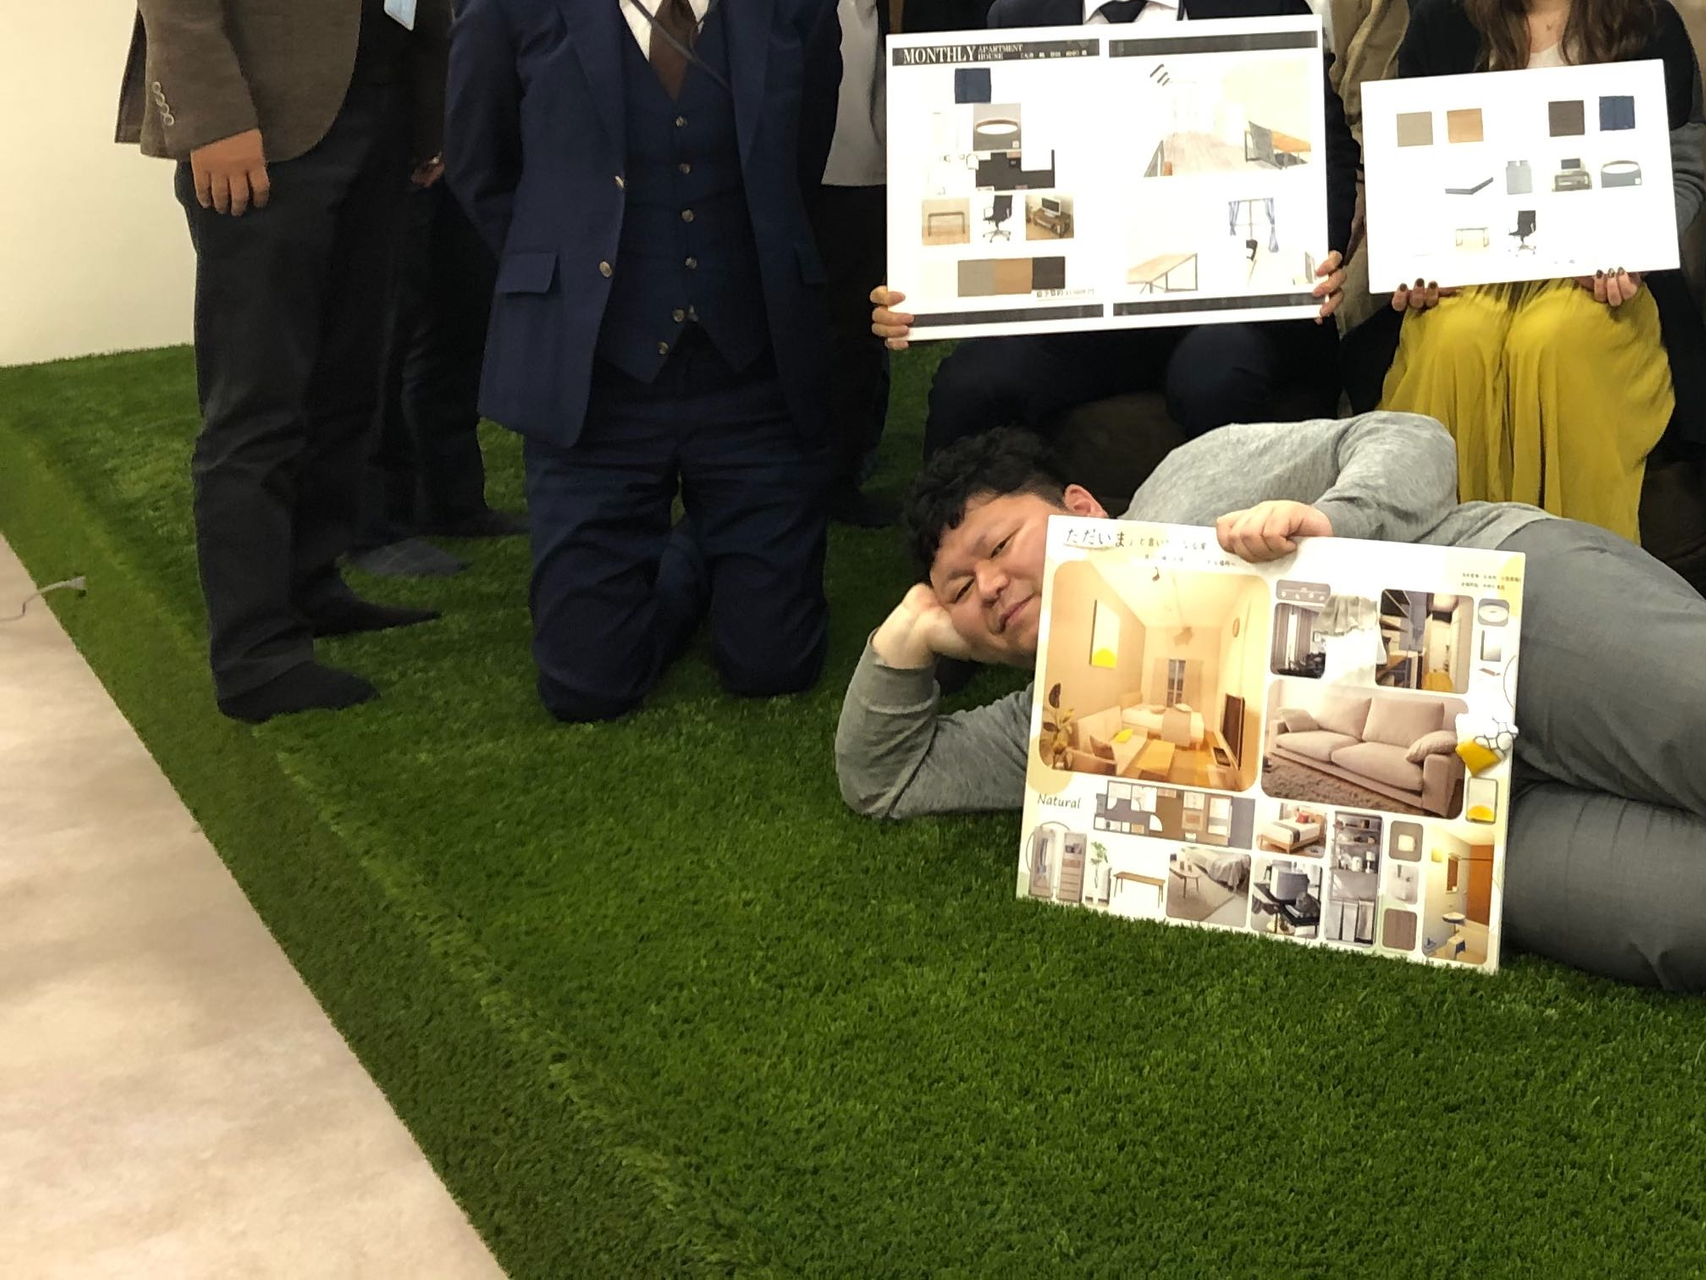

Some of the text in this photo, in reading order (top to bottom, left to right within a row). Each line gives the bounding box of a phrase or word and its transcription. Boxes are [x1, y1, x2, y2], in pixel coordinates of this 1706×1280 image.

[903, 44, 1023, 64] MONTHLY APARTMENT
[978, 52, 1004, 61] HOUSE
[1038, 793, 1081, 809] Natural
